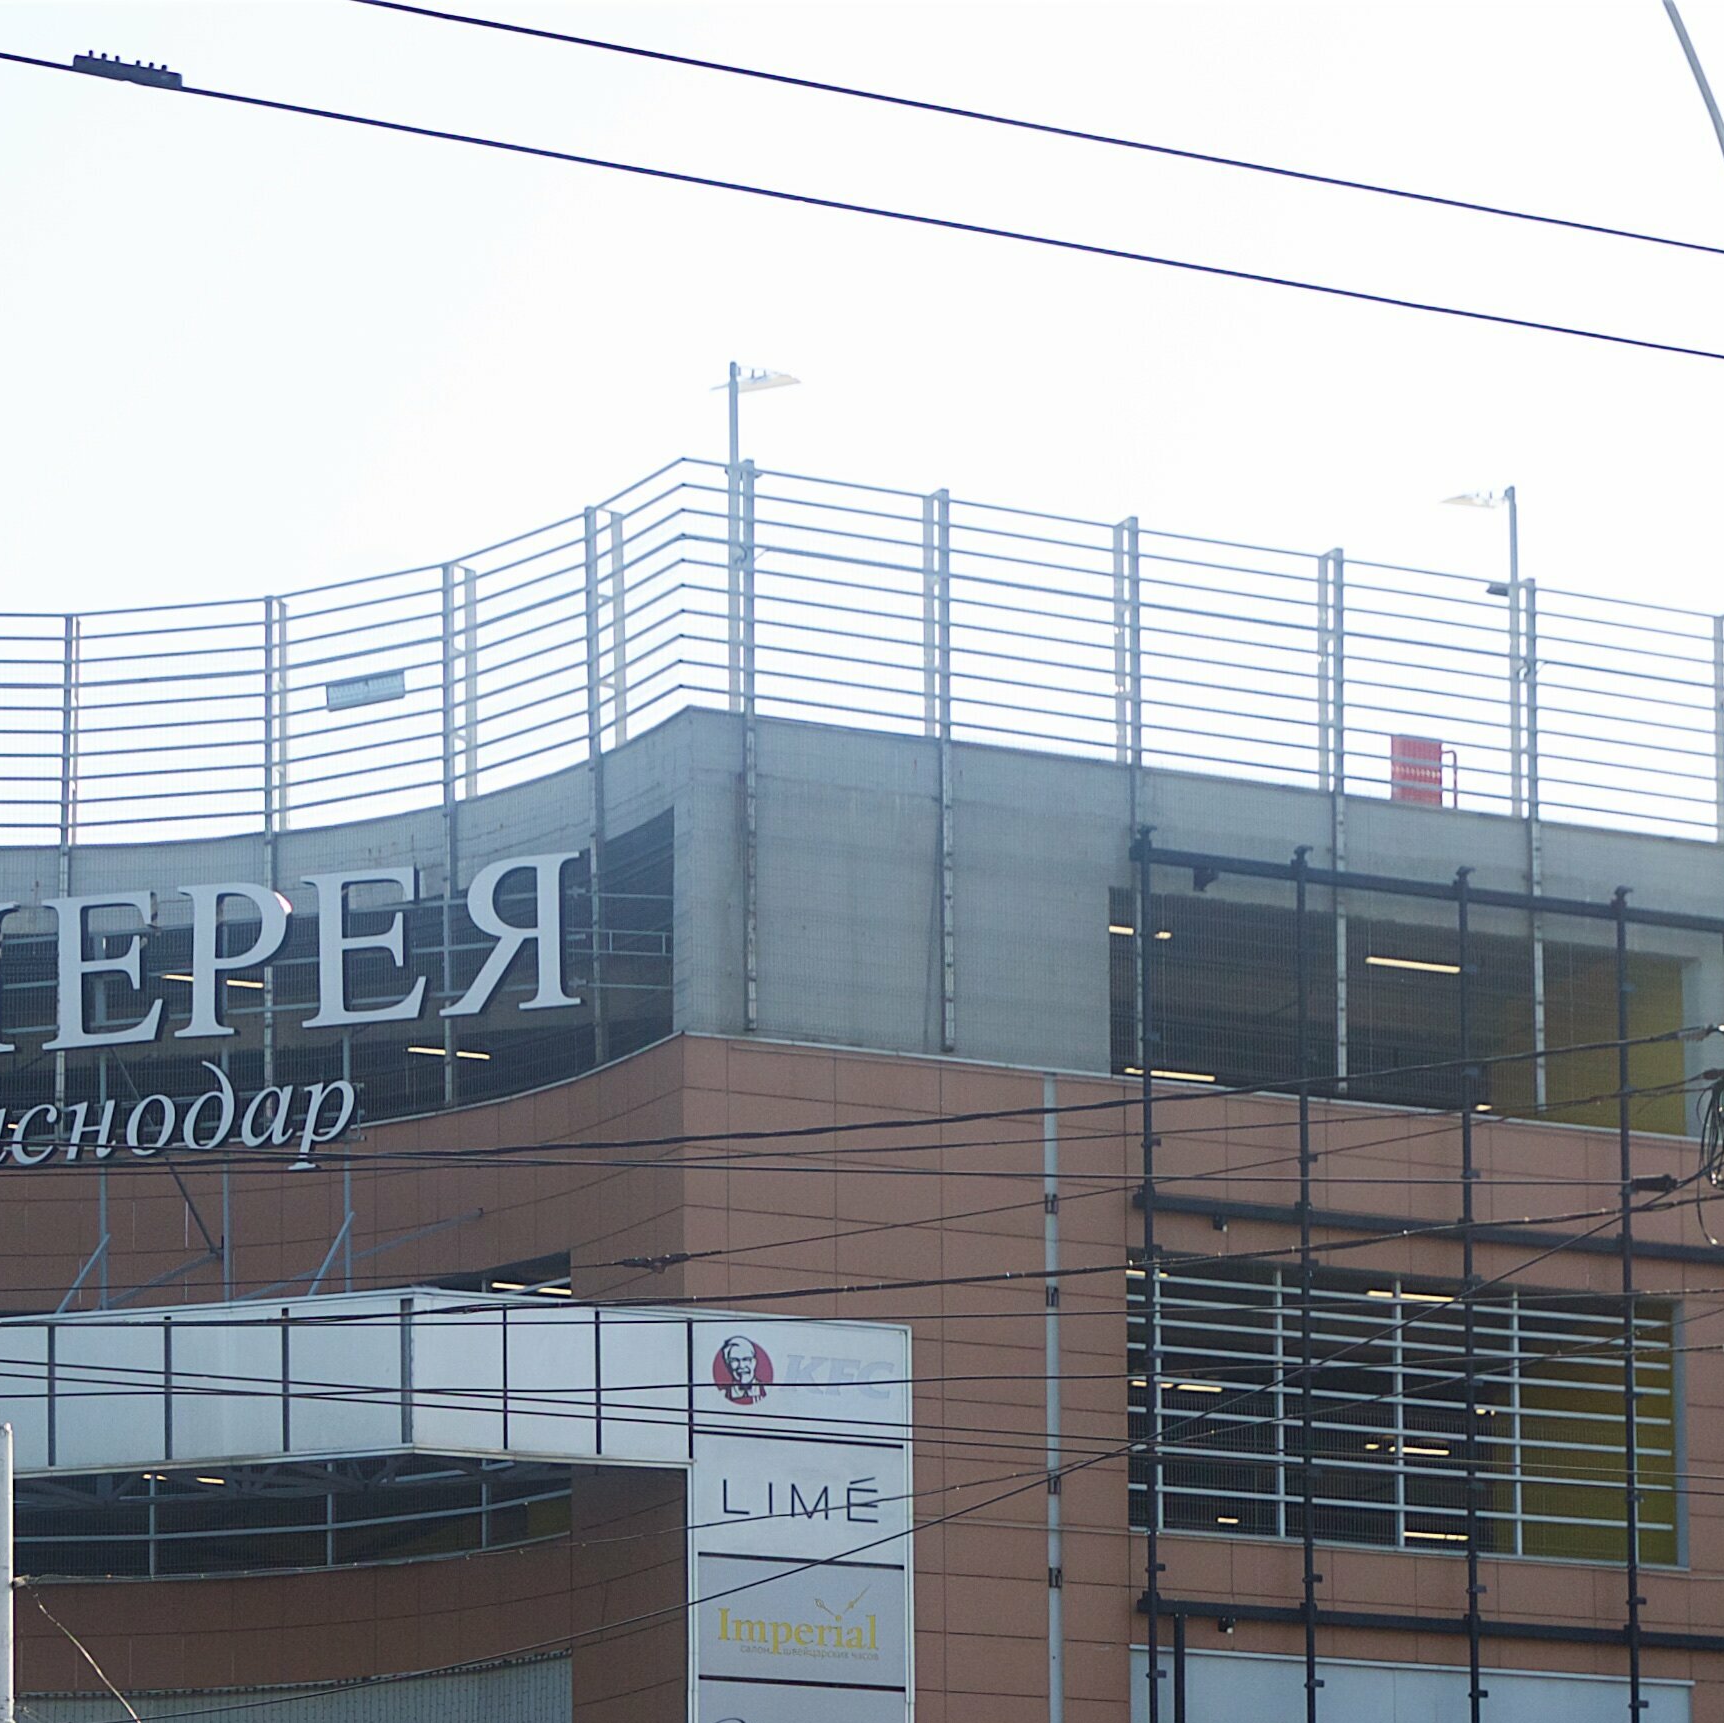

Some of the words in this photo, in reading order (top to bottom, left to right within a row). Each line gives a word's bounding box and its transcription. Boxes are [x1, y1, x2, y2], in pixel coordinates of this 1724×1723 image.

[778, 1354, 895, 1400] KFC
[722, 1476, 879, 1523] LIMÉ
[717, 1606, 880, 1656] Imperial
